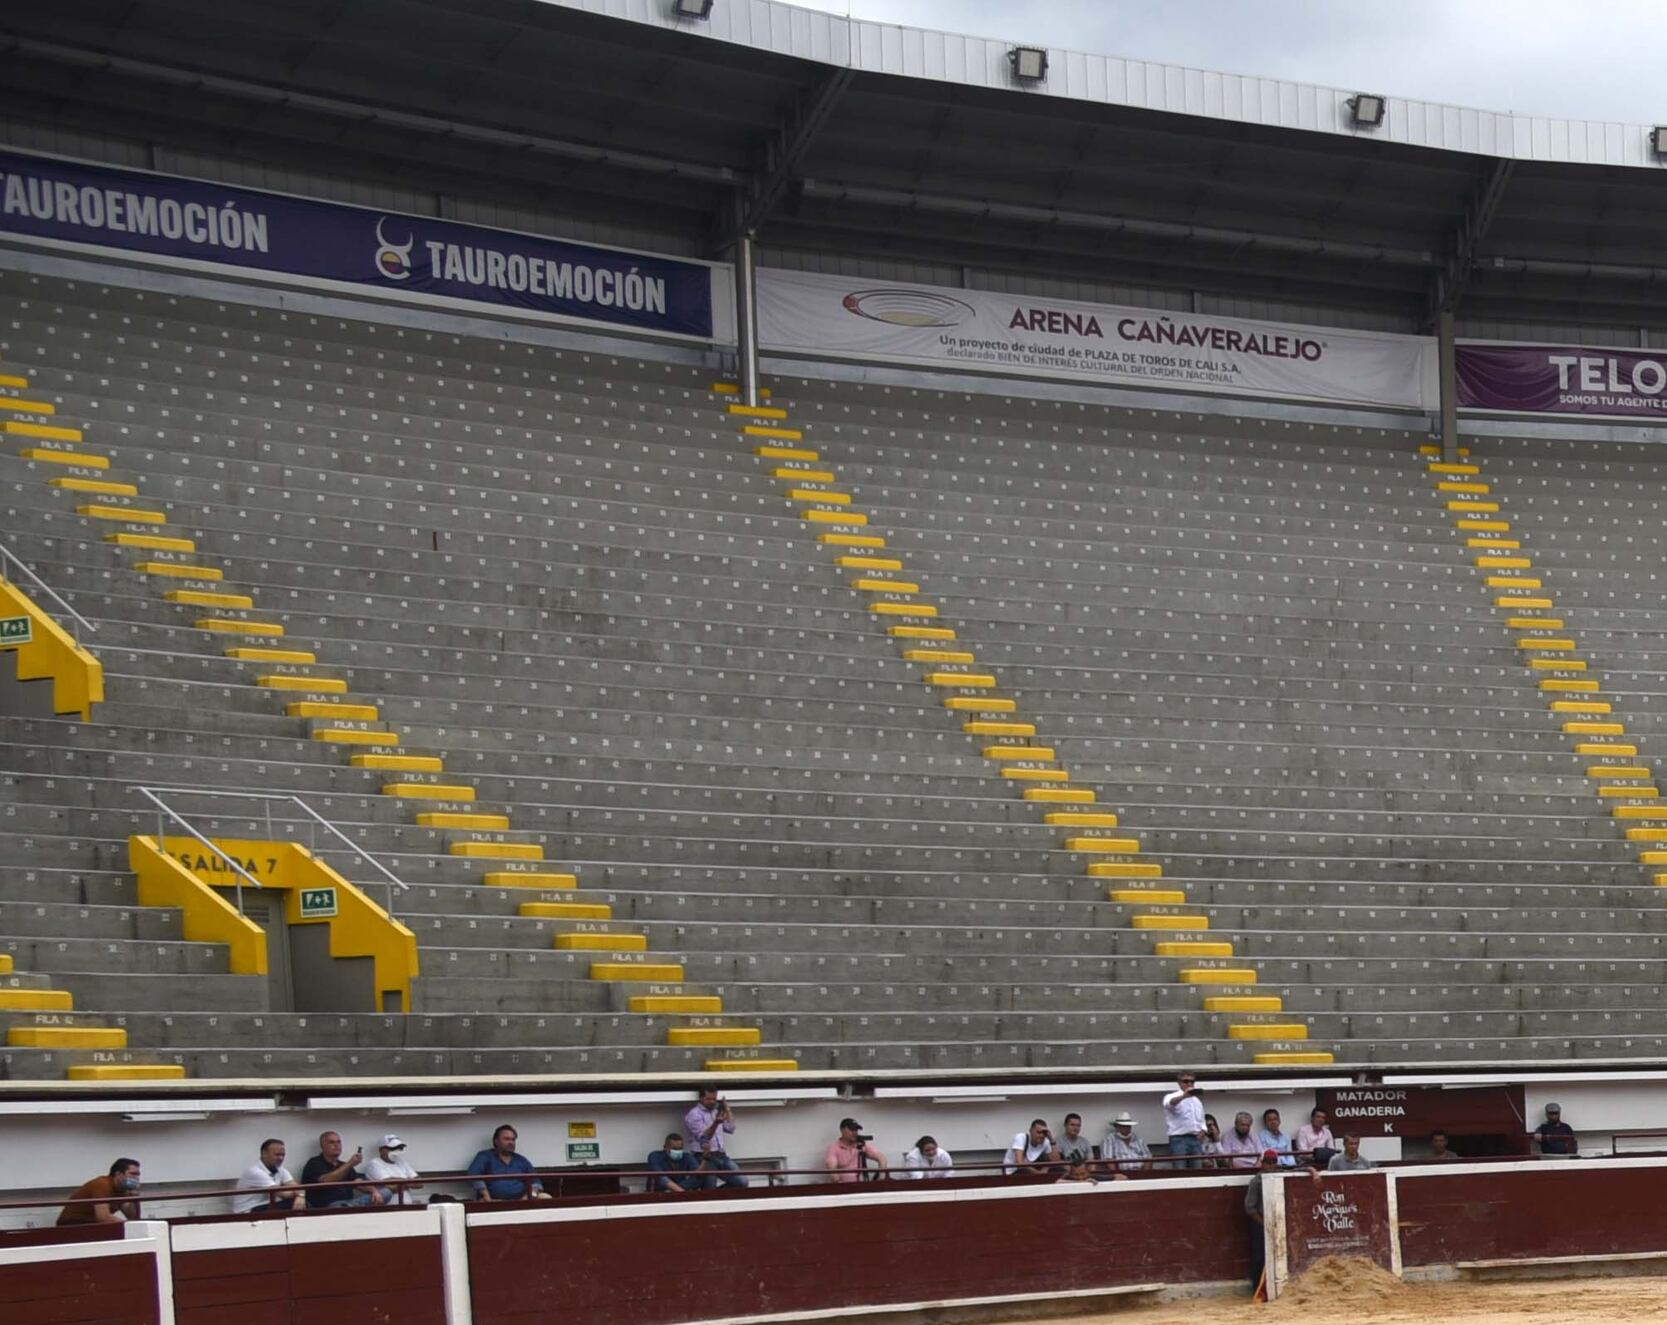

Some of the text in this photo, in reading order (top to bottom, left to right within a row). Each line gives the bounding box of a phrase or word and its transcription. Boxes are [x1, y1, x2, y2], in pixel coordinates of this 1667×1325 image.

[0, 172, 269, 253] AUROEMOCIÓN
[426, 240, 667, 314] TAUROEMOCIÓN
[1009, 307, 1323, 362] ARENA CAÑAVERALEJO
[939, 335, 1242, 374] Un proyecto de ciudad de PLAZA DE TOROS DE CALI S.A.
[1079, 360, 1129, 373] CULTURAL
[1130, 364, 1149, 376] DEL
[1150, 366, 1184, 379] ORDEN
[1185, 369, 1235, 384] NACIONAL
[1559, 394, 1598, 405] SOMOS
[1600, 396, 1614, 406] TU
[1617, 397, 1660, 408] AGENTE
[179, 853, 259, 874] SALIDA
[265, 858, 278, 874] 7
[1336, 1090, 1408, 1102] MATADOR
[1335, 1105, 1406, 1118] GANADERIA
[1383, 1122, 1394, 1133] K
